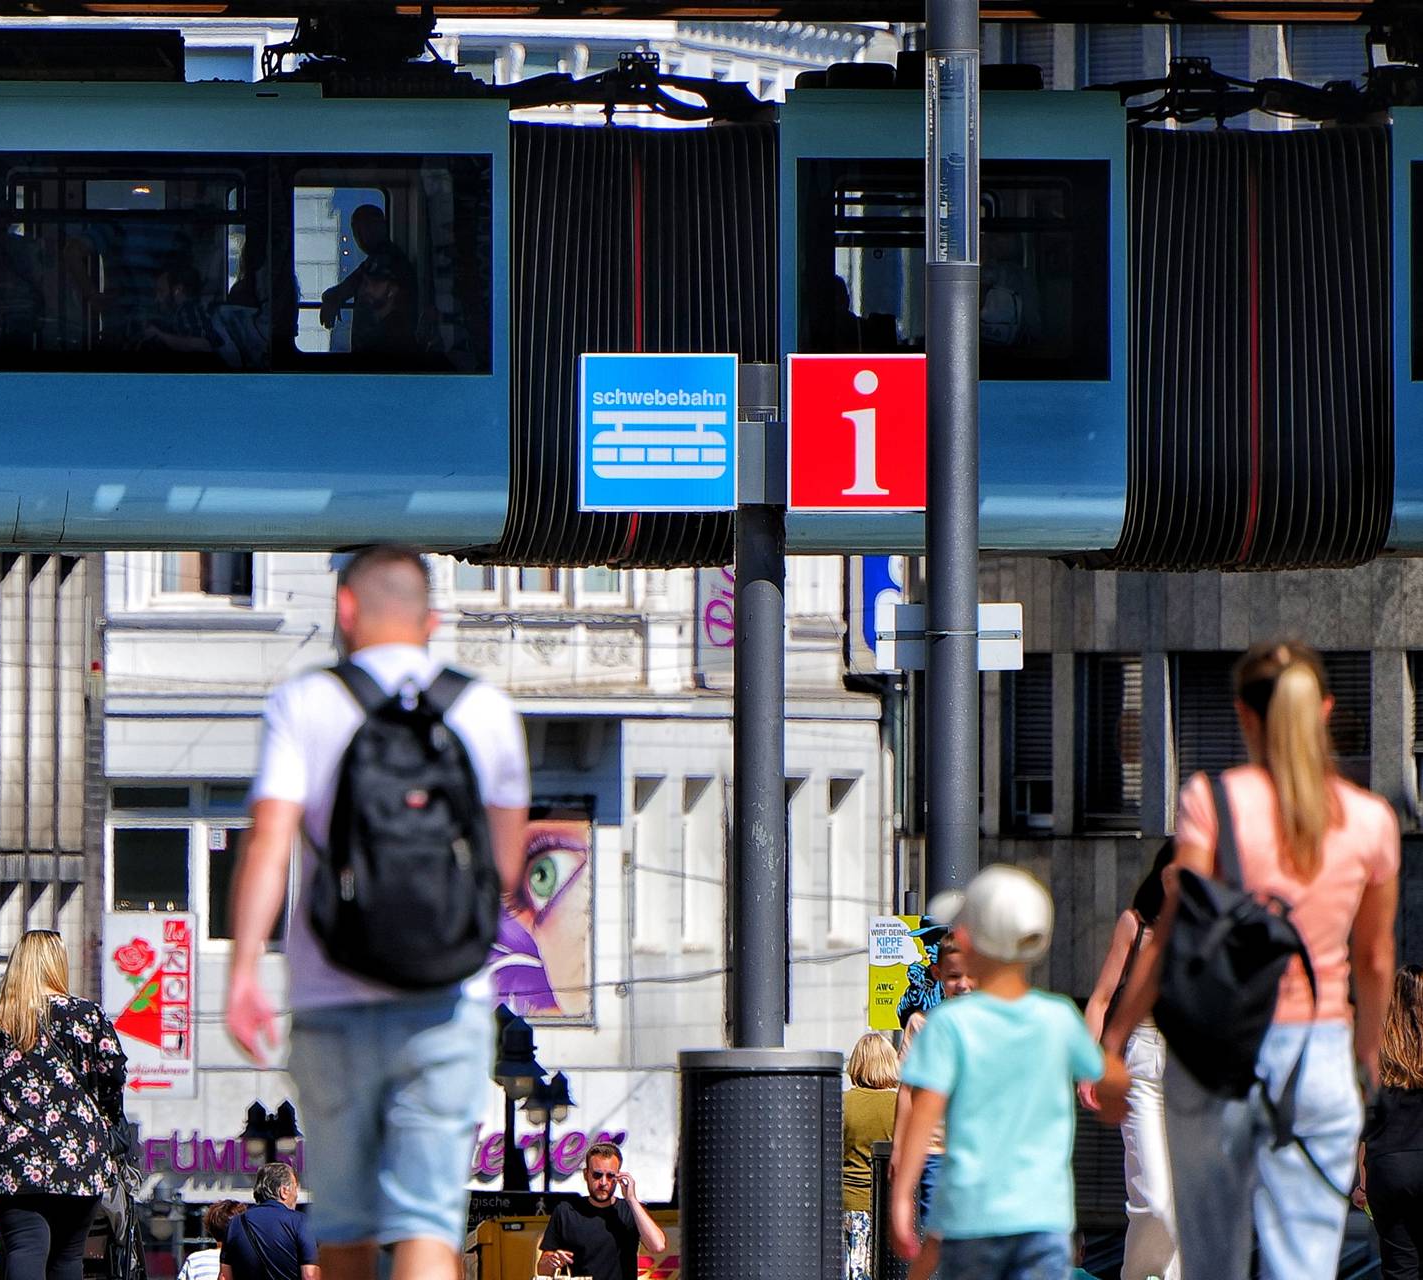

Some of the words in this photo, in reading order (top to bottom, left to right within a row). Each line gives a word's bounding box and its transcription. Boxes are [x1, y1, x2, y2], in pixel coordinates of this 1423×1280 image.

[592, 388, 727, 406] schwebebahn
[841, 369, 890, 495] i
[876, 937, 903, 946] KIPPE
